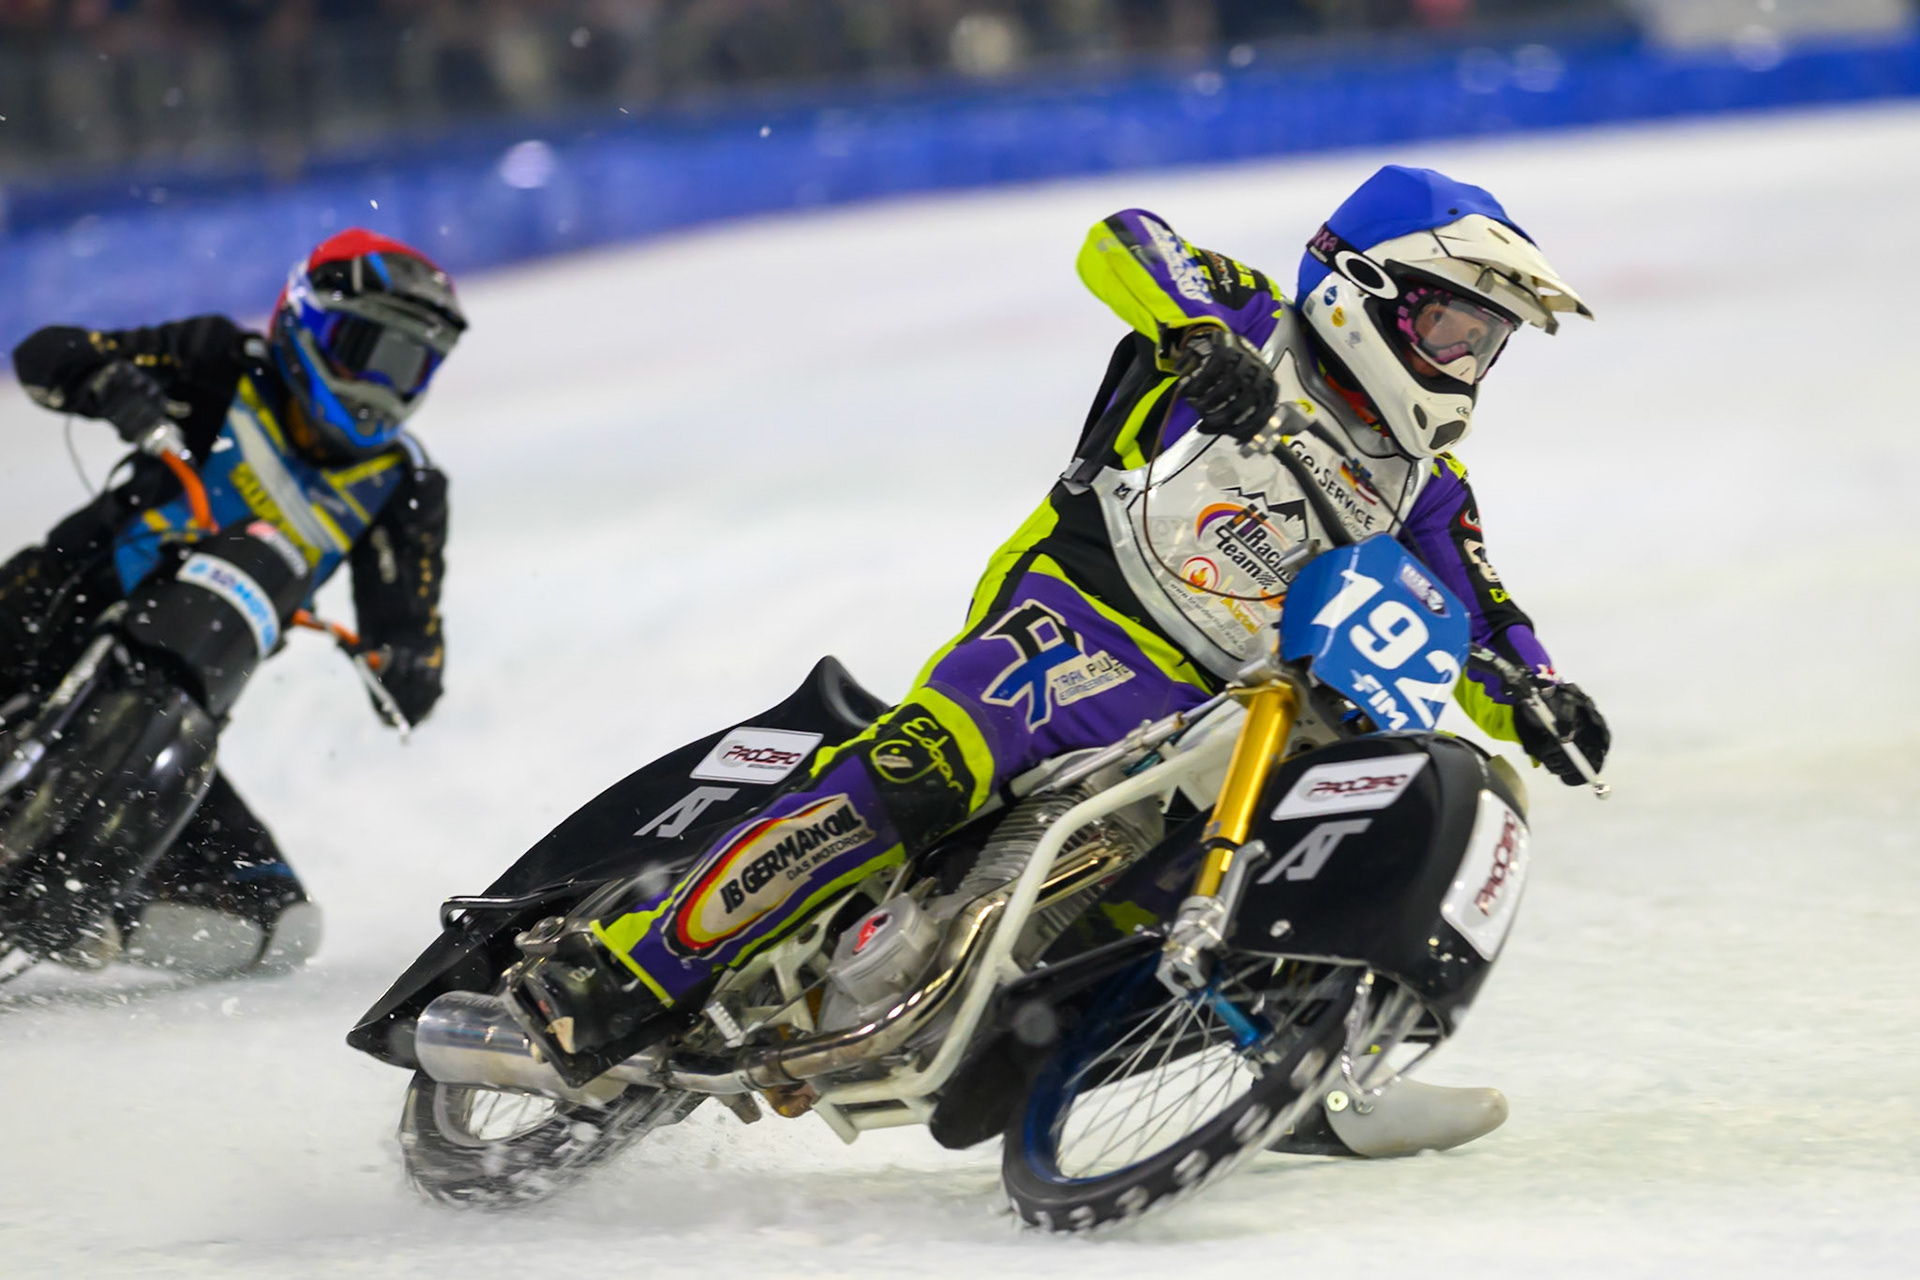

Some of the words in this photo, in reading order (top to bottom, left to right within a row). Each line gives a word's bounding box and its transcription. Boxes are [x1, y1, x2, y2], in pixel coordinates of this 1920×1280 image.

[1311, 569, 1461, 730] 192
[741, 823, 829, 894] GERMAN
[823, 804, 862, 837] OIL
